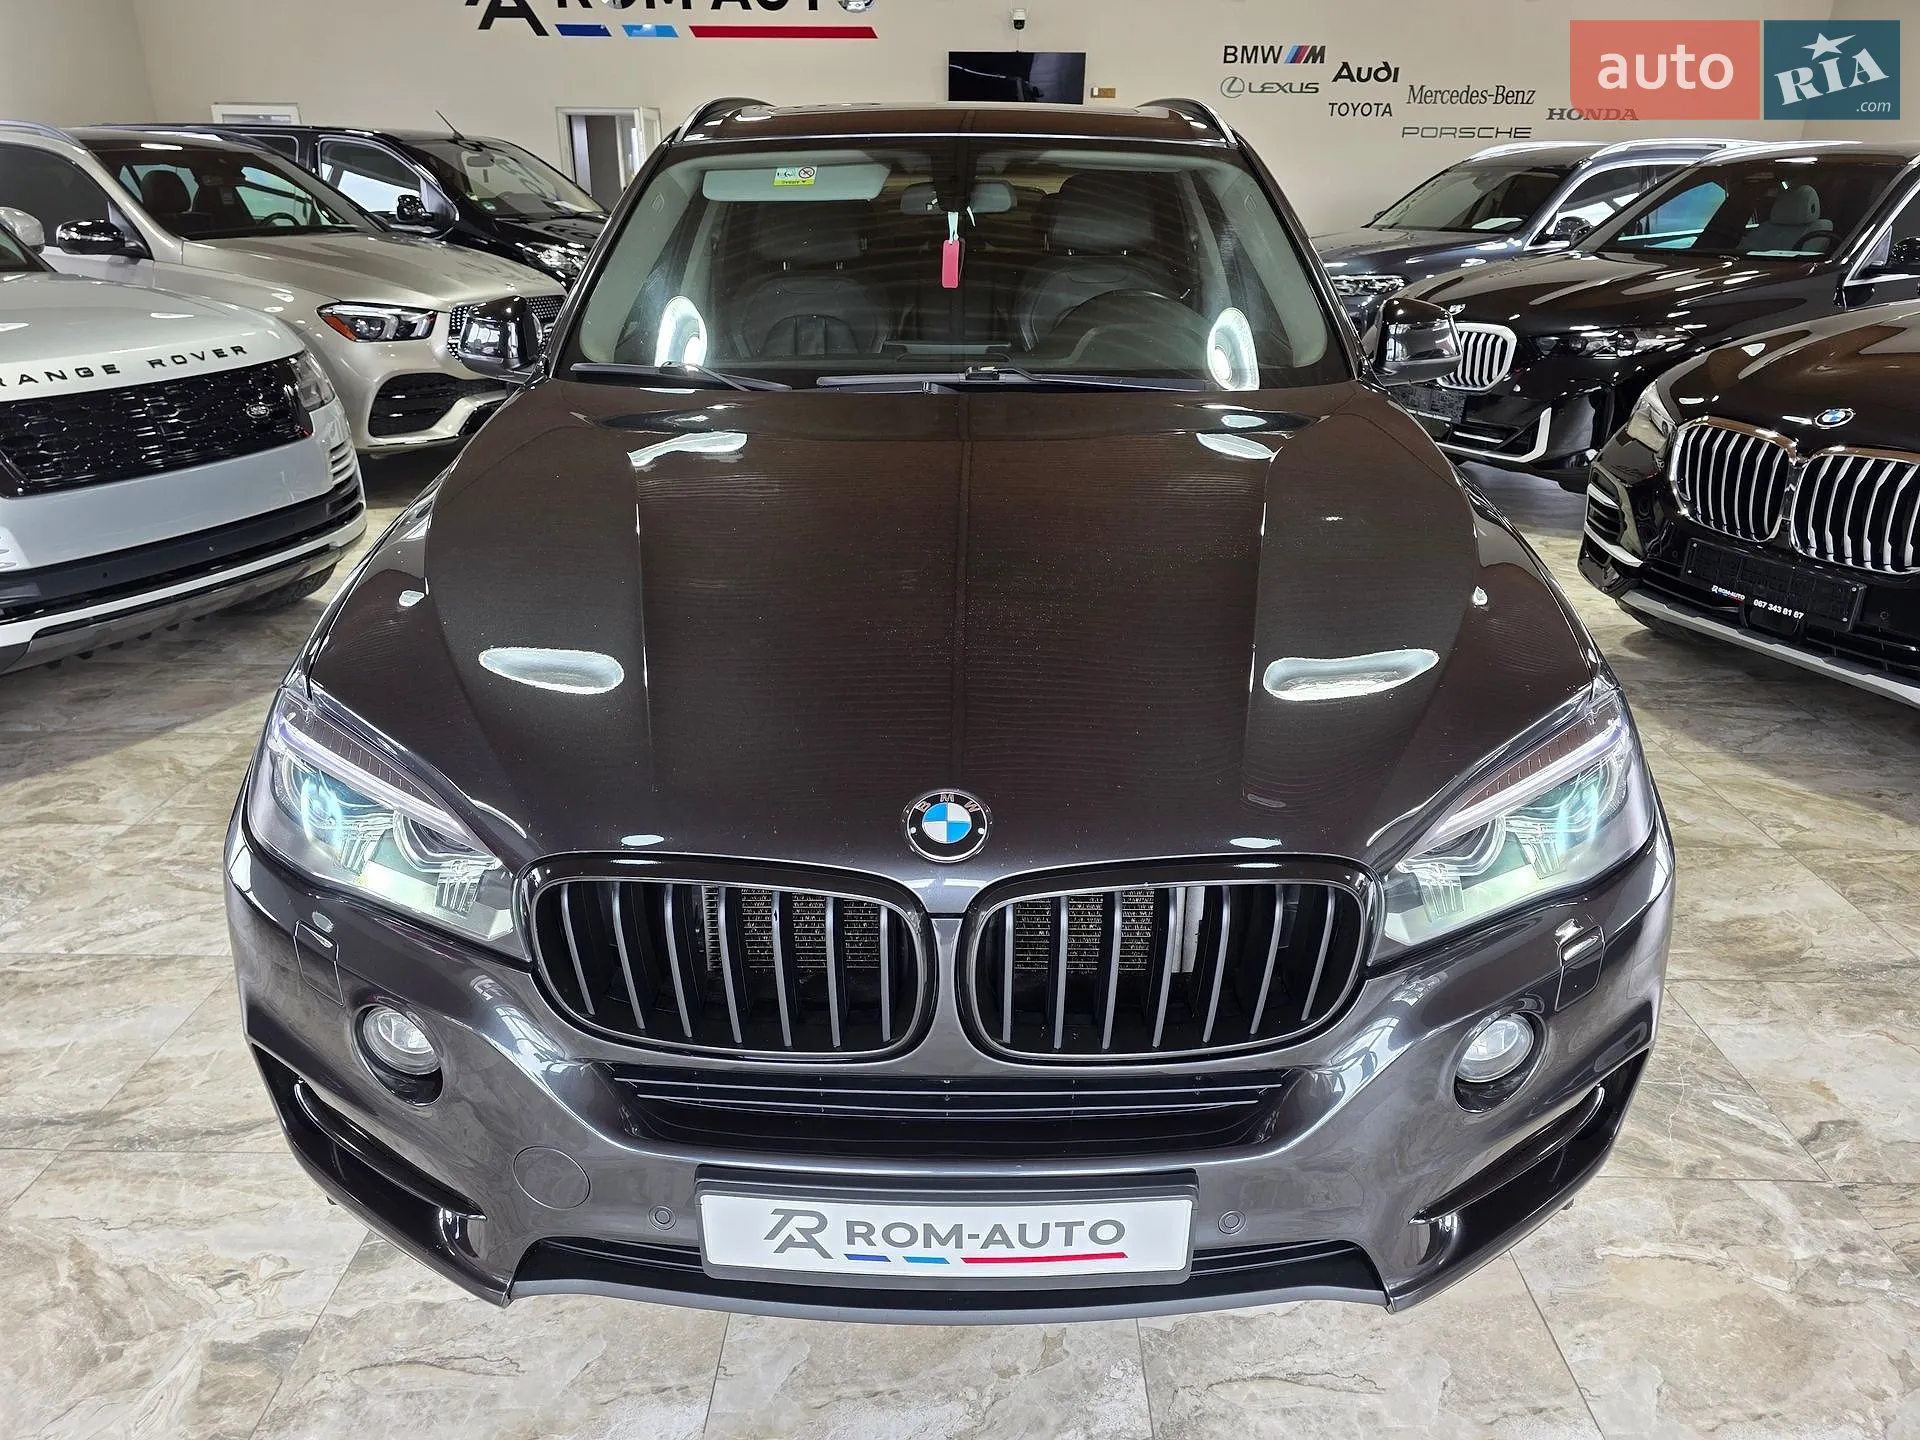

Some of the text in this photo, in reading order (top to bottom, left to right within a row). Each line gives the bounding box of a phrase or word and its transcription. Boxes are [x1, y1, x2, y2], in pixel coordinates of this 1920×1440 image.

[1223, 45, 1283, 64] BMW
[1332, 61, 1400, 83] Audi
[1248, 81, 1319, 95] LEXUS
[1406, 85, 1535, 106] Mercedes-Benz
[1328, 102, 1393, 117] TOYOTA
[1545, 107, 1639, 121] HONDA
[1401, 126, 1532, 139] PORSCHE
[147, 345, 248, 369] ROVER
[1768, 603, 1782, 613] 343
[915, 793, 981, 813] BMW
[846, 1218, 1126, 1250] ROM-AUTO
